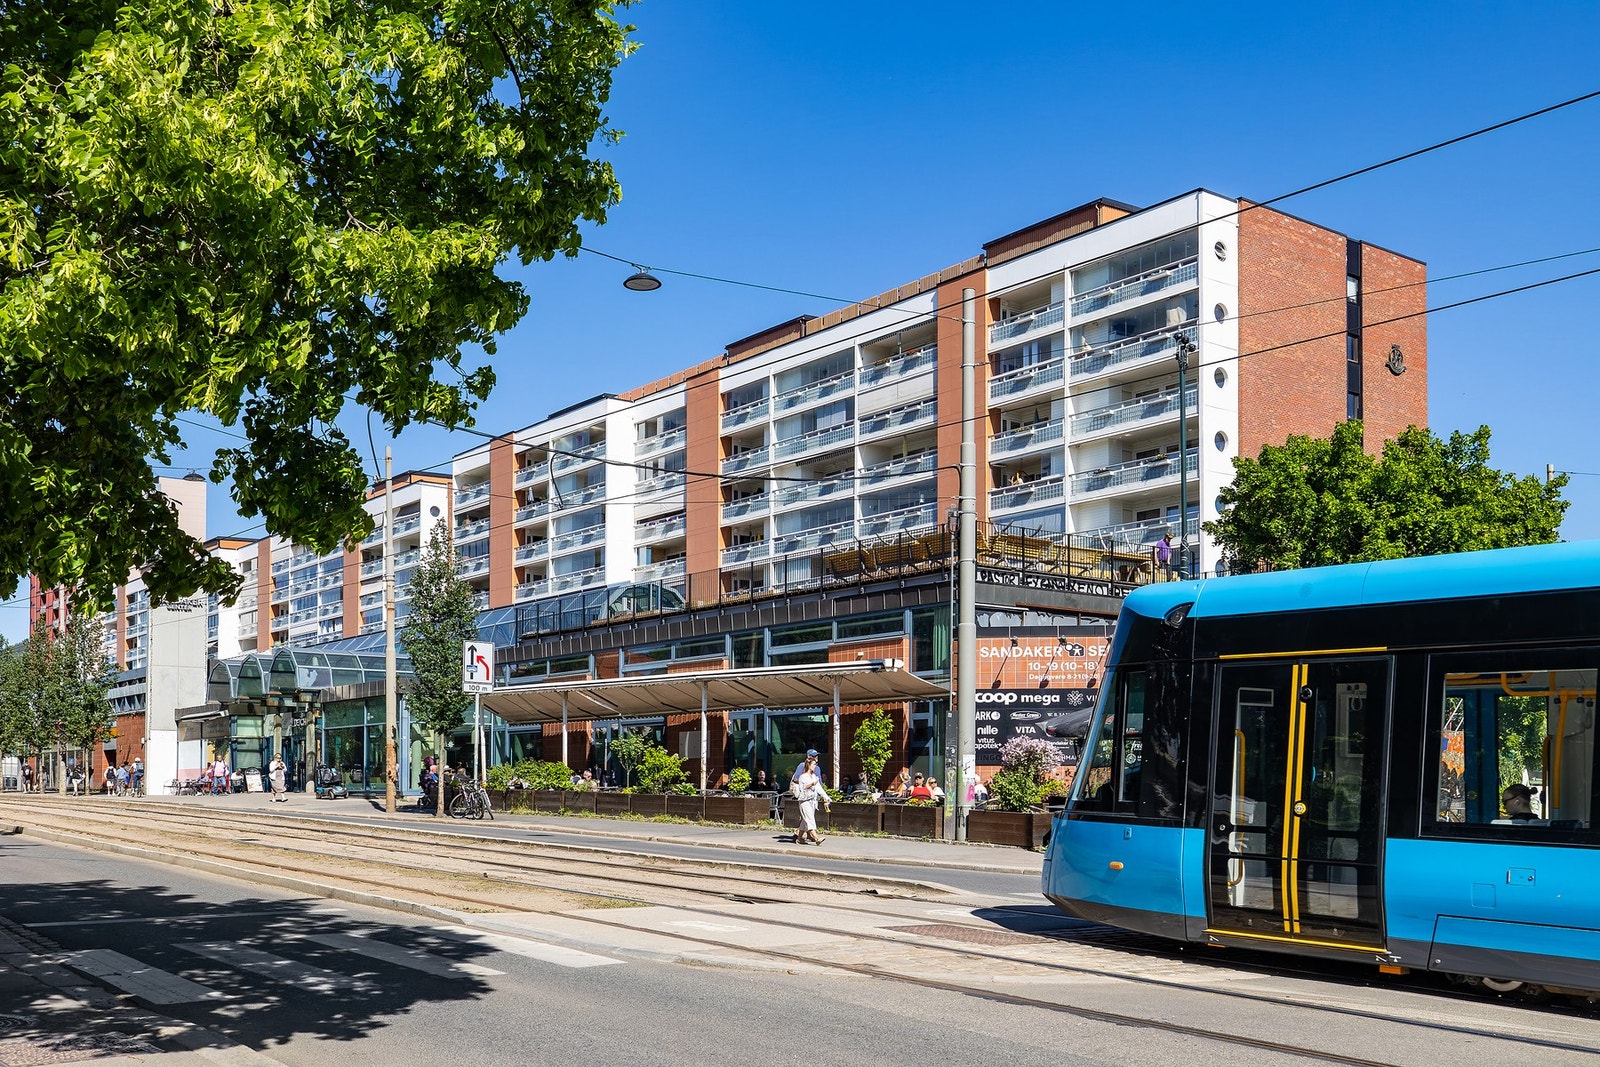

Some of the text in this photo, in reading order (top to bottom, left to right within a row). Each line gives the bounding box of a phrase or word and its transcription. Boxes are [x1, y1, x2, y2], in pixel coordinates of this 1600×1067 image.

[980, 646, 1063, 658] SANDAKER
[975, 692, 1018, 706] coop
[1020, 694, 1060, 706] mega
[977, 725, 999, 735] nille
[1015, 726, 1036, 734] VITA
